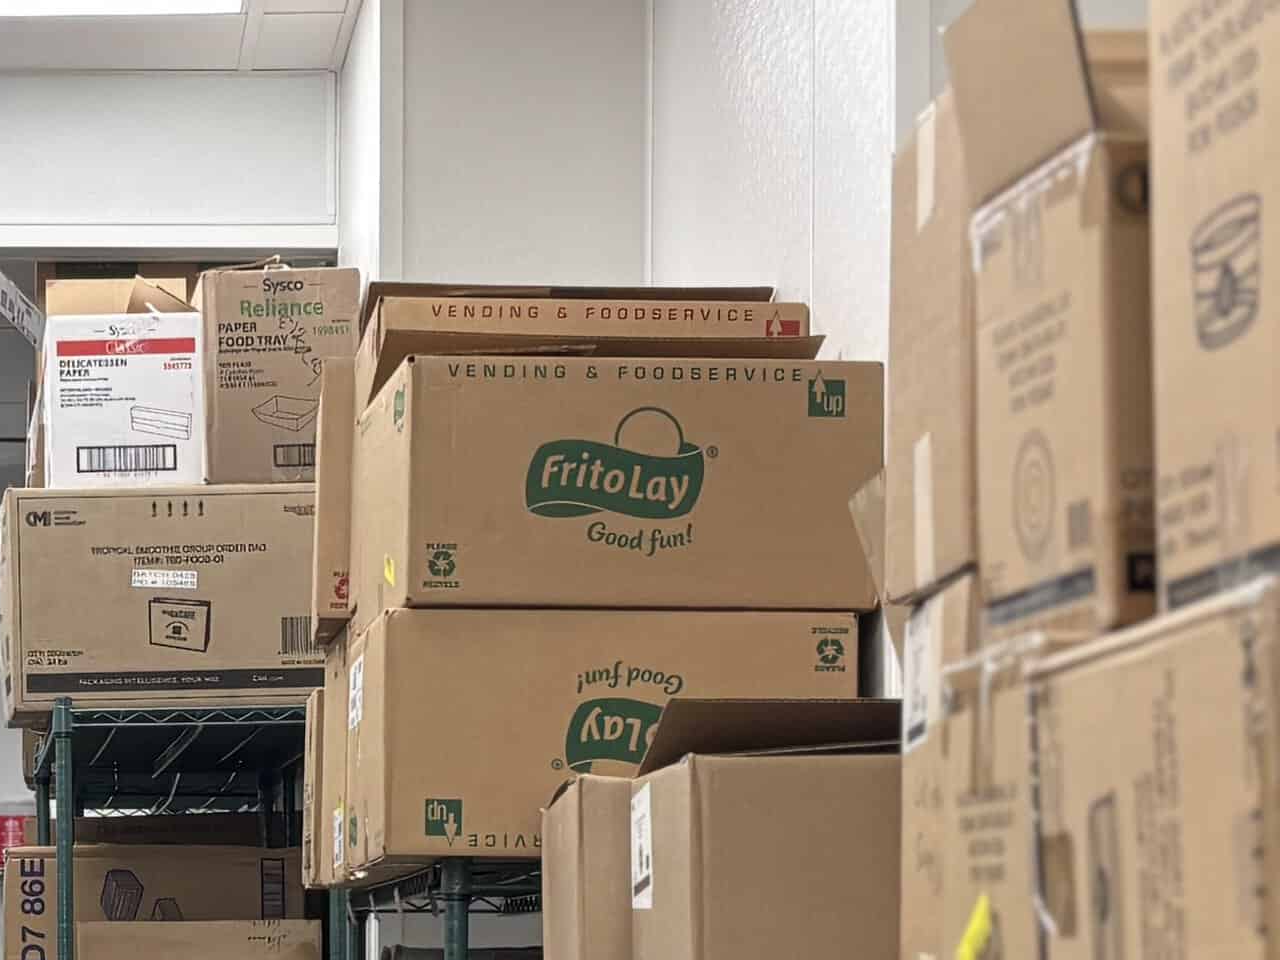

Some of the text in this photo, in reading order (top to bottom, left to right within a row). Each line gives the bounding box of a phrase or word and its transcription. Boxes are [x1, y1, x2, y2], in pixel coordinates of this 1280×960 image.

[262, 278, 304, 296] Sysco
[240, 298, 324, 318] Reliance
[431, 303, 755, 323] VENDING & FOODSERVICE
[218, 321, 258, 334] PAPER
[218, 335, 289, 348] FOOD TRAY
[59, 358, 128, 369] DELICATESSEN
[59, 369, 91, 378] PAPER
[447, 362, 804, 383] VENDING & FOODSERVICE
[822, 394, 845, 416] up
[586, 521, 693, 557] Good fun!
[576, 660, 684, 696] Good fun!
[427, 801, 448, 822] up
[20, 858, 45, 916] 86E
